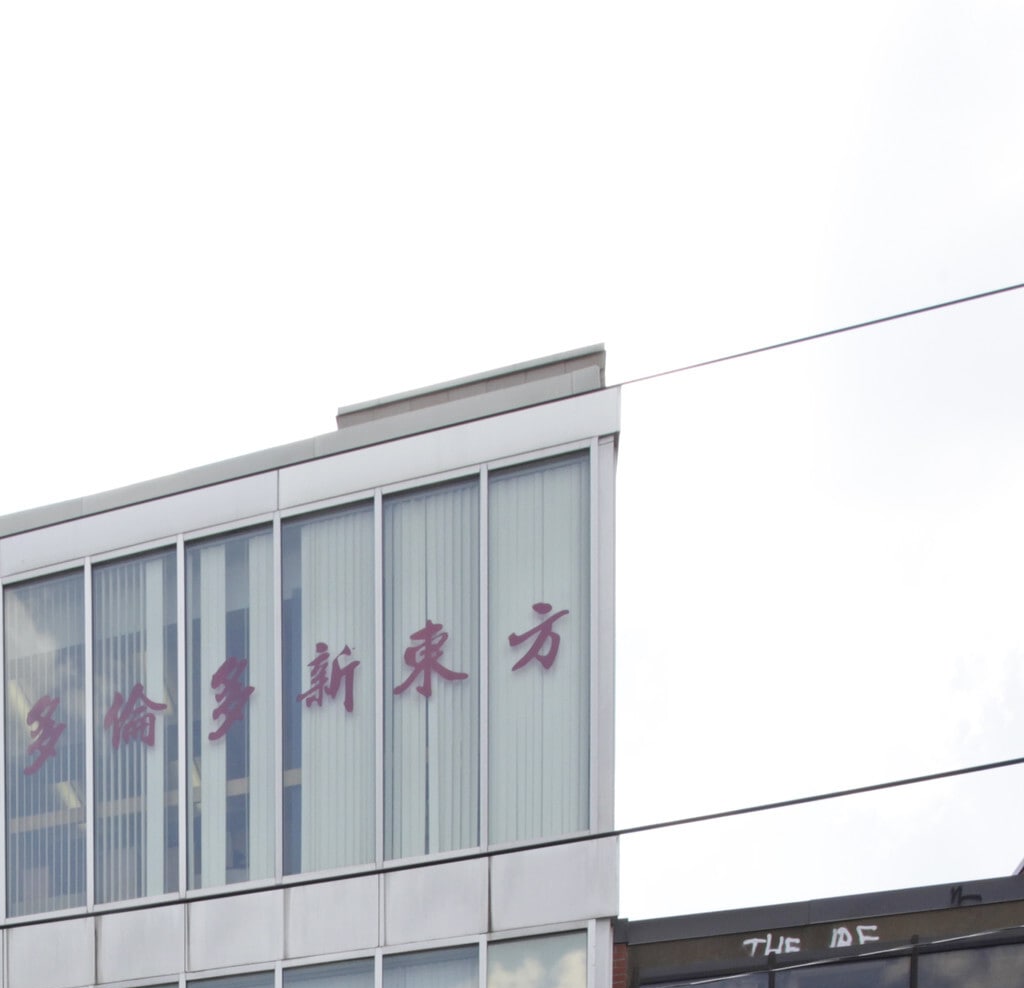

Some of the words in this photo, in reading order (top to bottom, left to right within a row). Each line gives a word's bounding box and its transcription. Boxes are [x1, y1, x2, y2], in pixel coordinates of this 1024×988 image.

[23, 601, 570, 776] 多倫多新東方
[743, 933, 801, 957] THE
